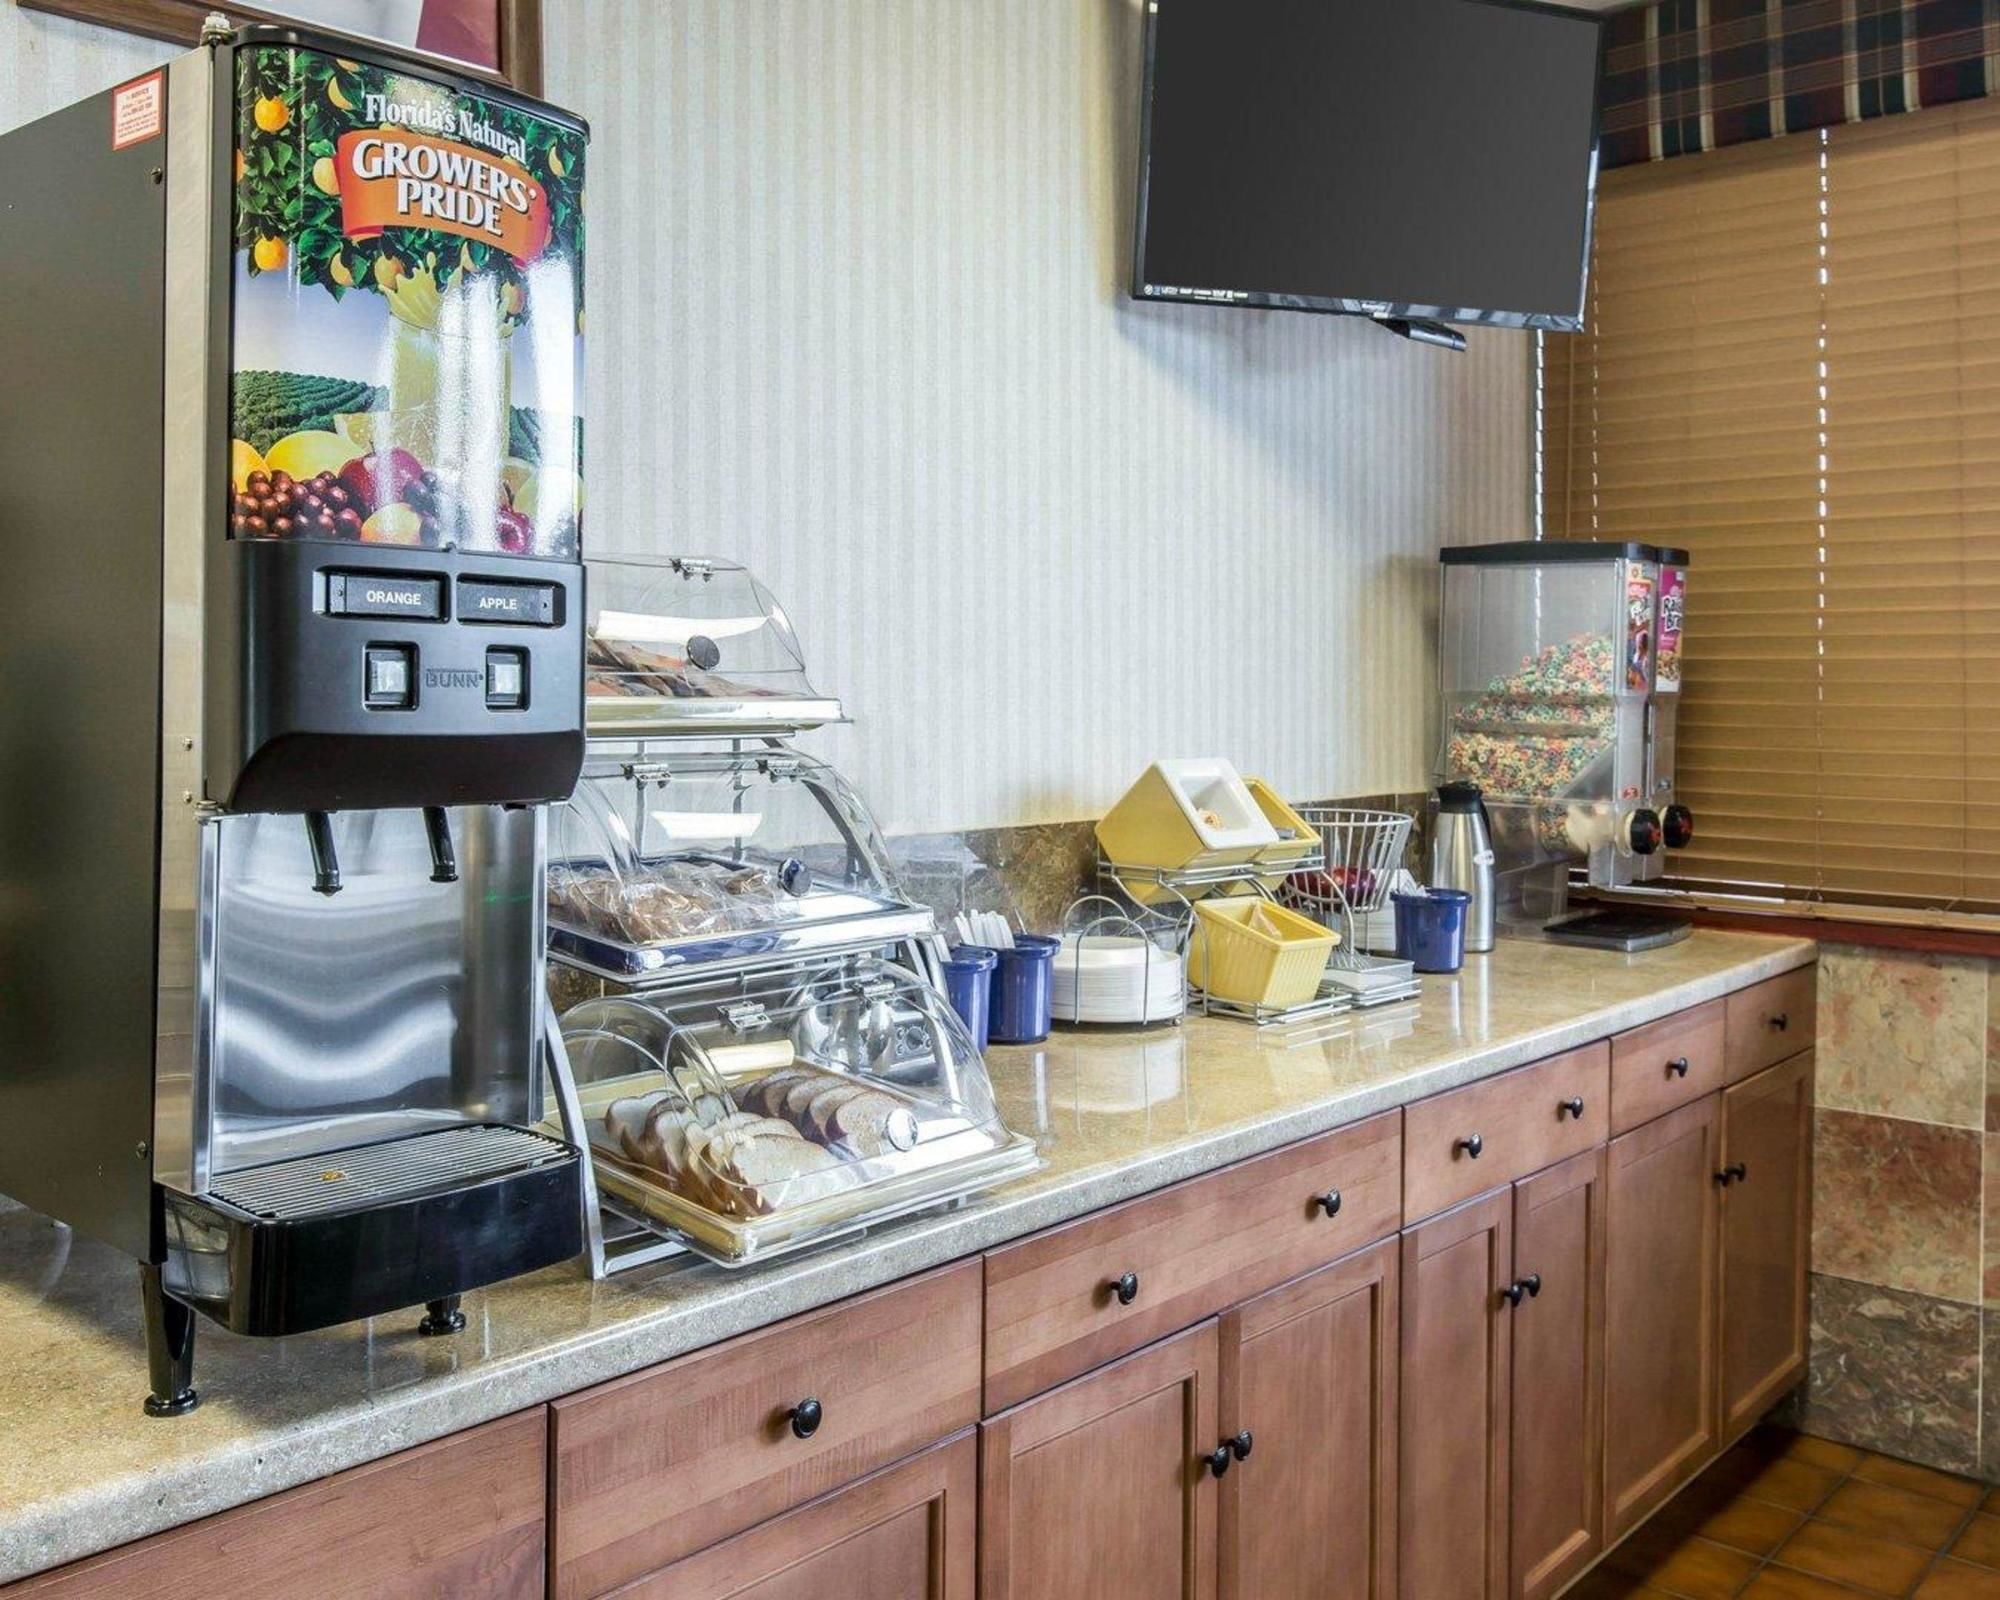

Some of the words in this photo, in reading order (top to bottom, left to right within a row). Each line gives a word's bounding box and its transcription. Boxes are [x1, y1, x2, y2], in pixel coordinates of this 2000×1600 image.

[365, 94, 456, 137] Florida's
[458, 109, 527, 165] Natural
[397, 178, 503, 237] PRIDE
[366, 590, 422, 605] ORANGE
[478, 597, 518, 610] APPLE
[425, 668, 481, 688] BUNN
